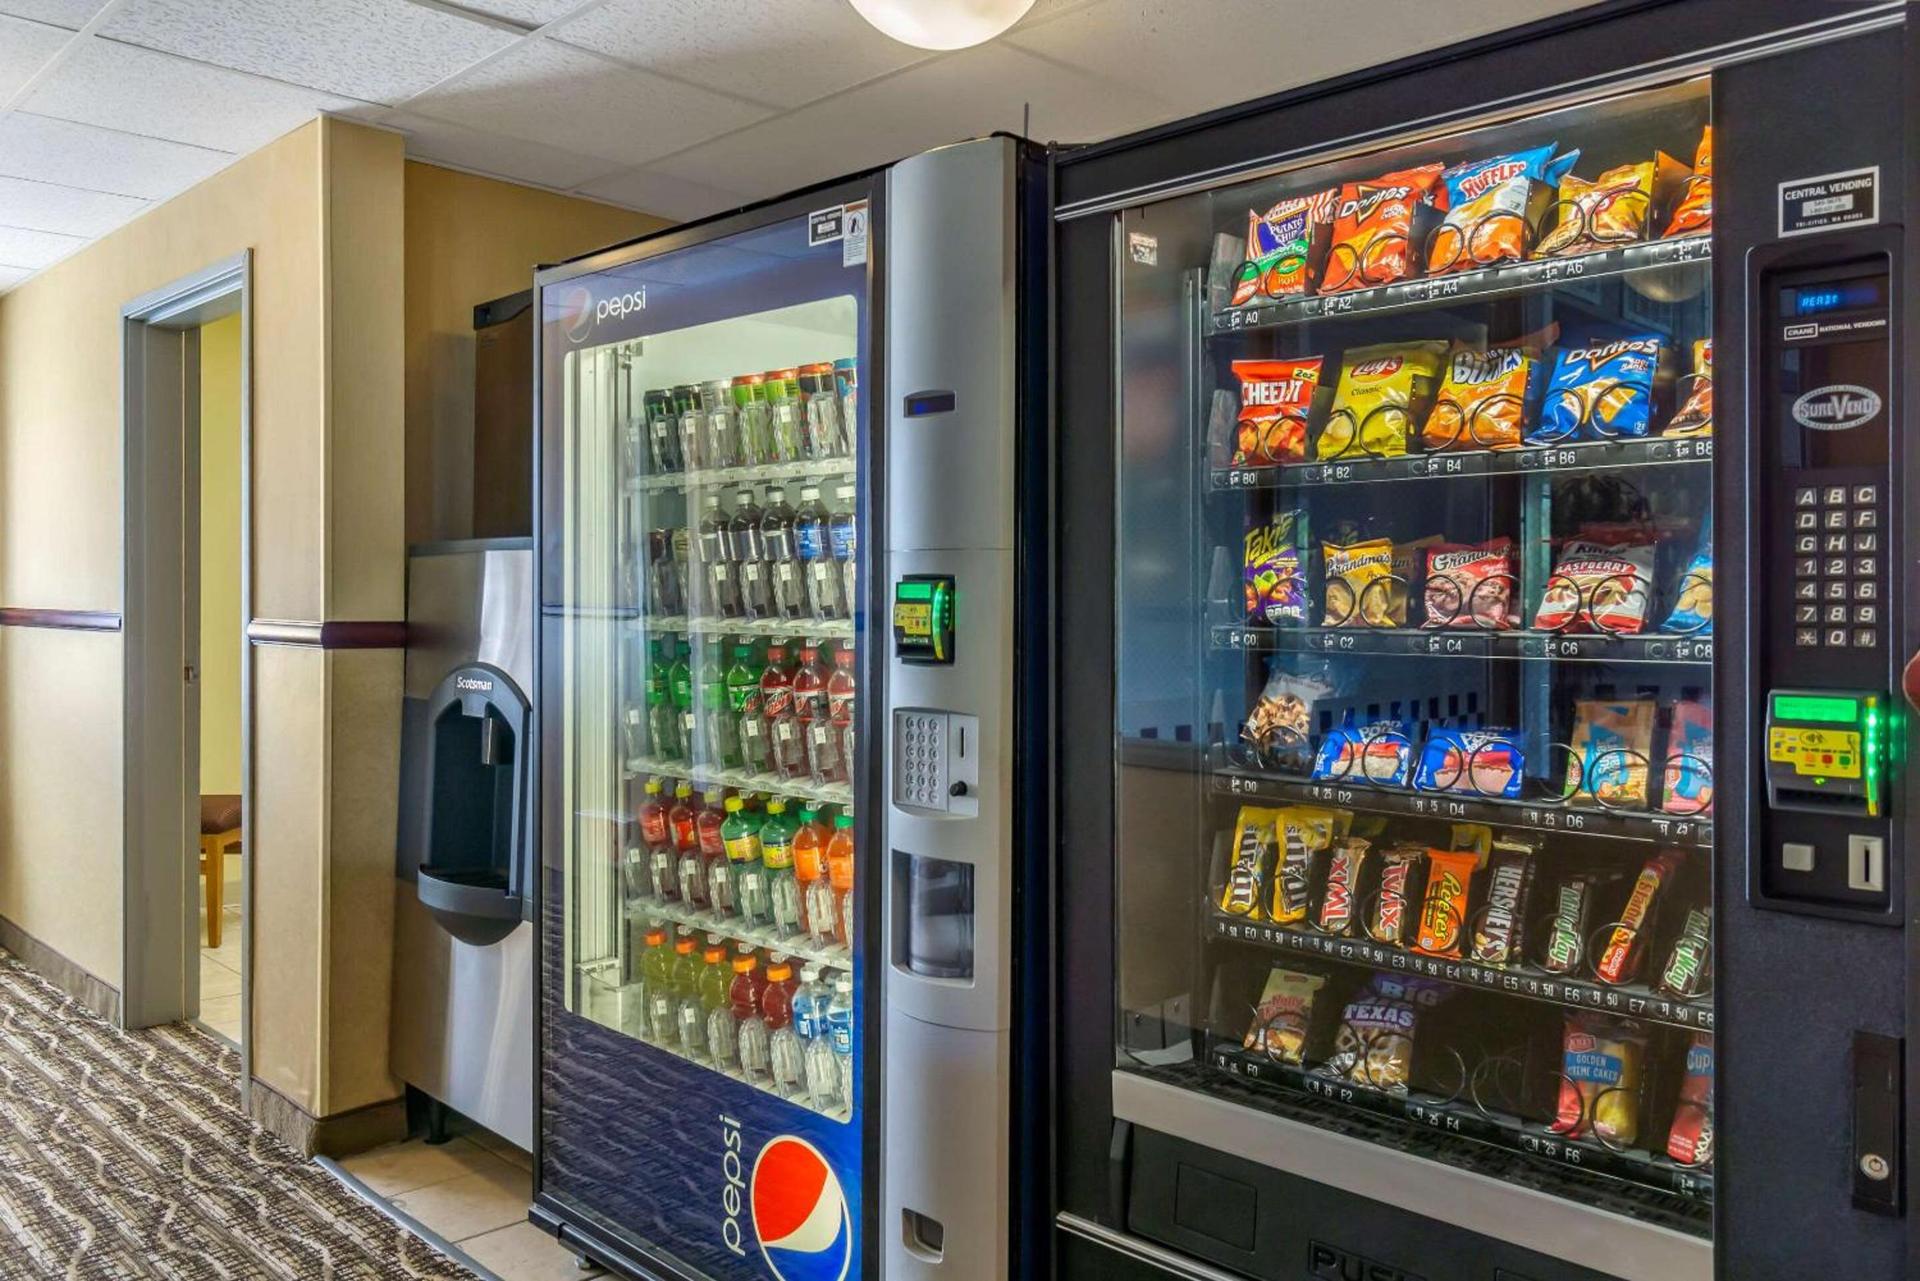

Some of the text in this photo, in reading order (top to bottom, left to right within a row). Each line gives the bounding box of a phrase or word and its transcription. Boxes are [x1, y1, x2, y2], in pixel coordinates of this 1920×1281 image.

[1459, 162, 1526, 200] RUFFLES
[1785, 177, 1872, 200] CENTRAL VENDING
[1341, 186, 1410, 217] Doritos
[1566, 262, 1583, 275] A6
[1443, 282, 1458, 294] A4
[597, 284, 646, 325] pepsi
[1338, 299, 1351, 310] A2
[1246, 311, 1258, 324] A0
[1787, 327, 1815, 337] CRANE
[1565, 339, 1659, 365] Doritos
[1559, 451, 1576, 464] B6
[1446, 460, 1461, 472] B4
[1800, 488, 1873, 504] A B C
[1800, 512, 1872, 528] D E F
[1801, 535, 1872, 551] G H J
[1432, 544, 1511, 571] Grands
[1556, 560, 1631, 574] RASPBERRY
[1804, 559, 1873, 574] 1 2 3
[1802, 583, 1873, 598] 4 5 6
[1803, 607, 1873, 621] 7 8 9
[1243, 634, 1256, 646] C0
[1340, 637, 1354, 648] C2
[1447, 640, 1462, 652] C4
[1561, 642, 1578, 655] C6
[1694, 644, 1712, 658] C8
[456, 676, 493, 691] Scotsman
[1245, 780, 1257, 792] D0
[1338, 791, 1352, 803] D2
[1450, 803, 1465, 815] D4
[1566, 815, 1584, 828] D6
[1320, 857, 1351, 926] TWIX
[1380, 860, 1409, 931] TWIX
[1484, 866, 1523, 952] HERSHEY'S
[1245, 928, 1257, 939] E0
[1292, 936, 1303, 947] E1
[1340, 945, 1353, 958] E2
[1392, 955, 1405, 968] E3
[1446, 966, 1460, 978] E4
[1504, 977, 1518, 990] E5
[1565, 987, 1580, 1001] E6
[1629, 999, 1645, 1013] E7
[1344, 1003, 1414, 1027] TEXAS
[1341, 1089, 1353, 1102] F2
[1447, 1117, 1460, 1131] F4
[1565, 1148, 1581, 1163] F6
[718, 1114, 746, 1257] pepsi
[1314, 1246, 1404, 1281] PUS
